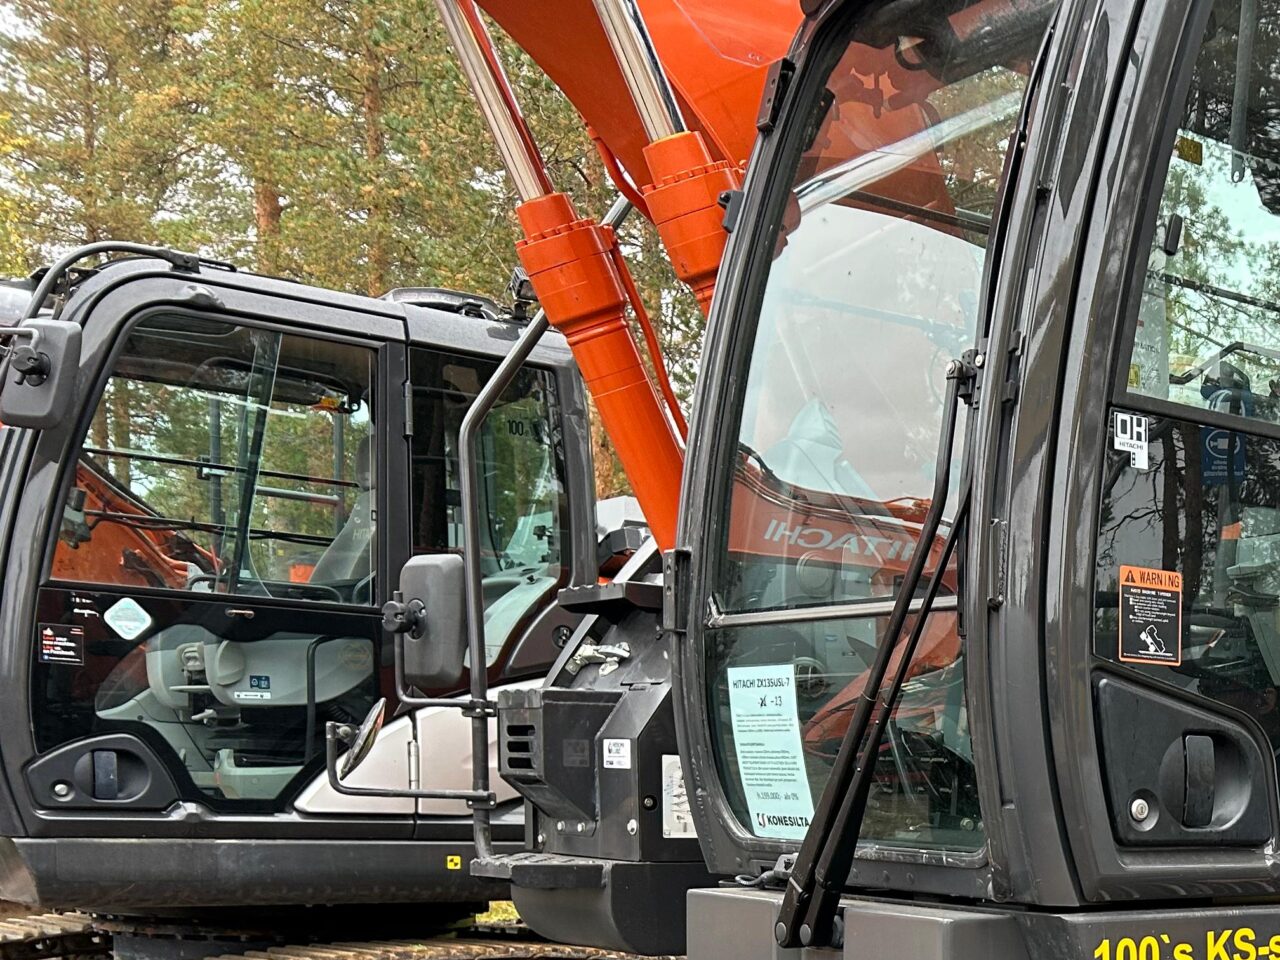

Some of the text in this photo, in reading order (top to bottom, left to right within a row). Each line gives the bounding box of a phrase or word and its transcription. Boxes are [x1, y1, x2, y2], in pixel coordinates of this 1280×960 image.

[1119, 441, 1144, 451] HITACHI
[1139, 570, 1180, 588] WARNING
[733, 679, 755, 689] HITACHI
[767, 815, 810, 827] KONESILTA
